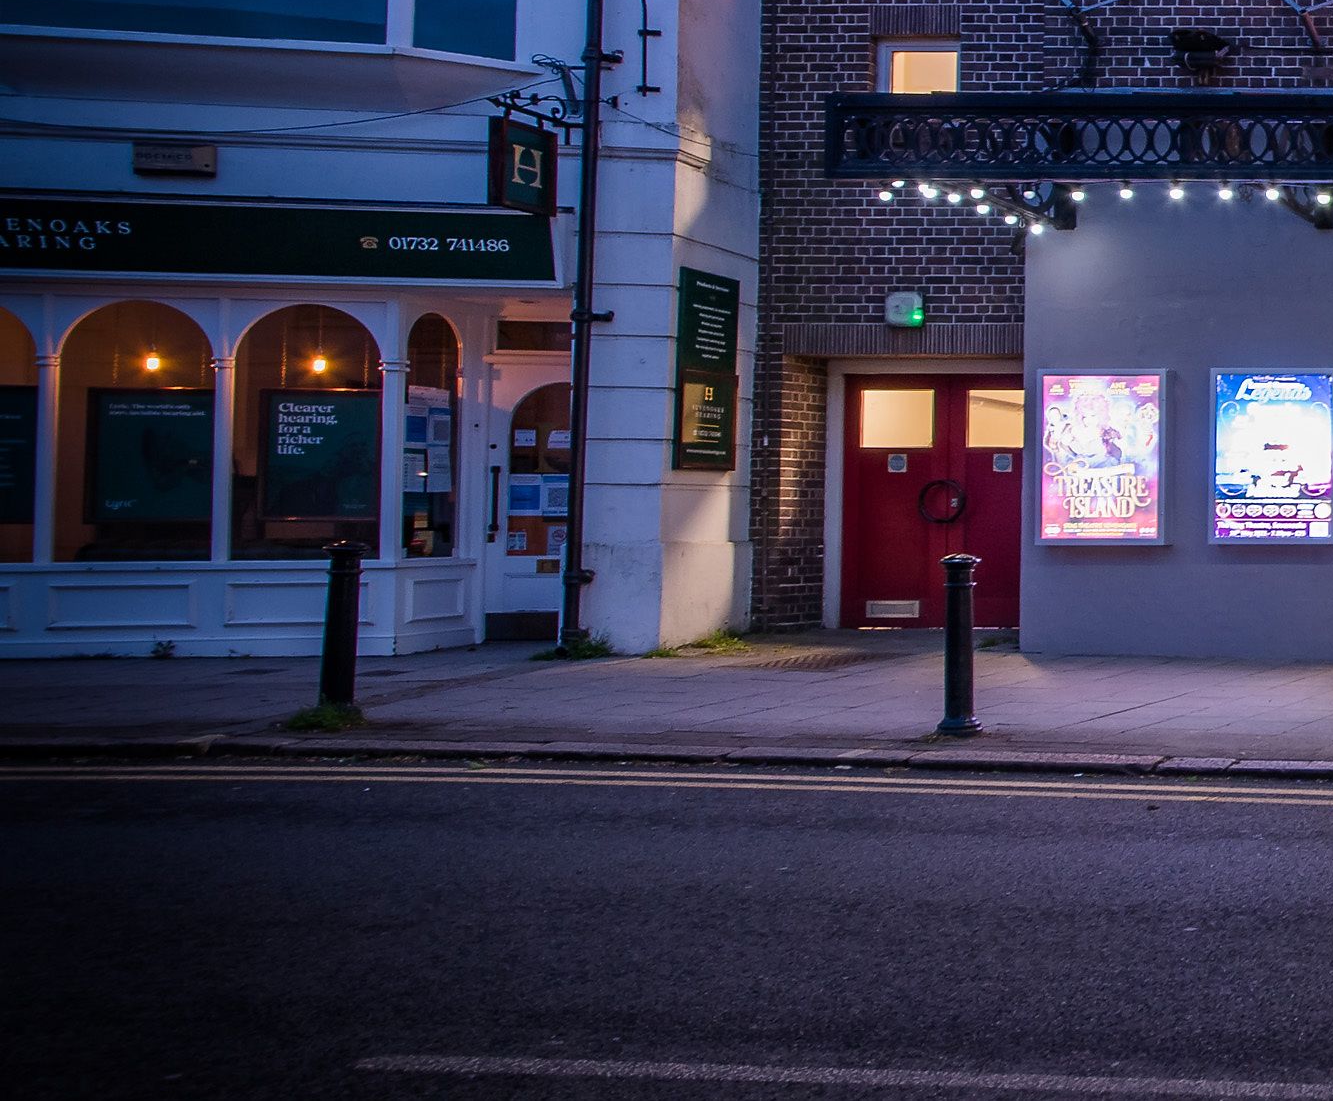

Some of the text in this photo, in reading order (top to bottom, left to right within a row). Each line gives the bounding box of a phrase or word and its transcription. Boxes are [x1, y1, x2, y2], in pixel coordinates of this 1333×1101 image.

[511, 144, 543, 189] H
[6, 218, 132, 235] ENOAKS
[388, 236, 510, 252] 01732 741486
[278, 403, 335, 413] Clearer
[278, 424, 300, 433] for
[278, 434, 323, 444] richer
[277, 444, 305, 455] life.
[1053, 475, 1151, 501] TREASURE
[1062, 496, 1136, 518] ISLAND
